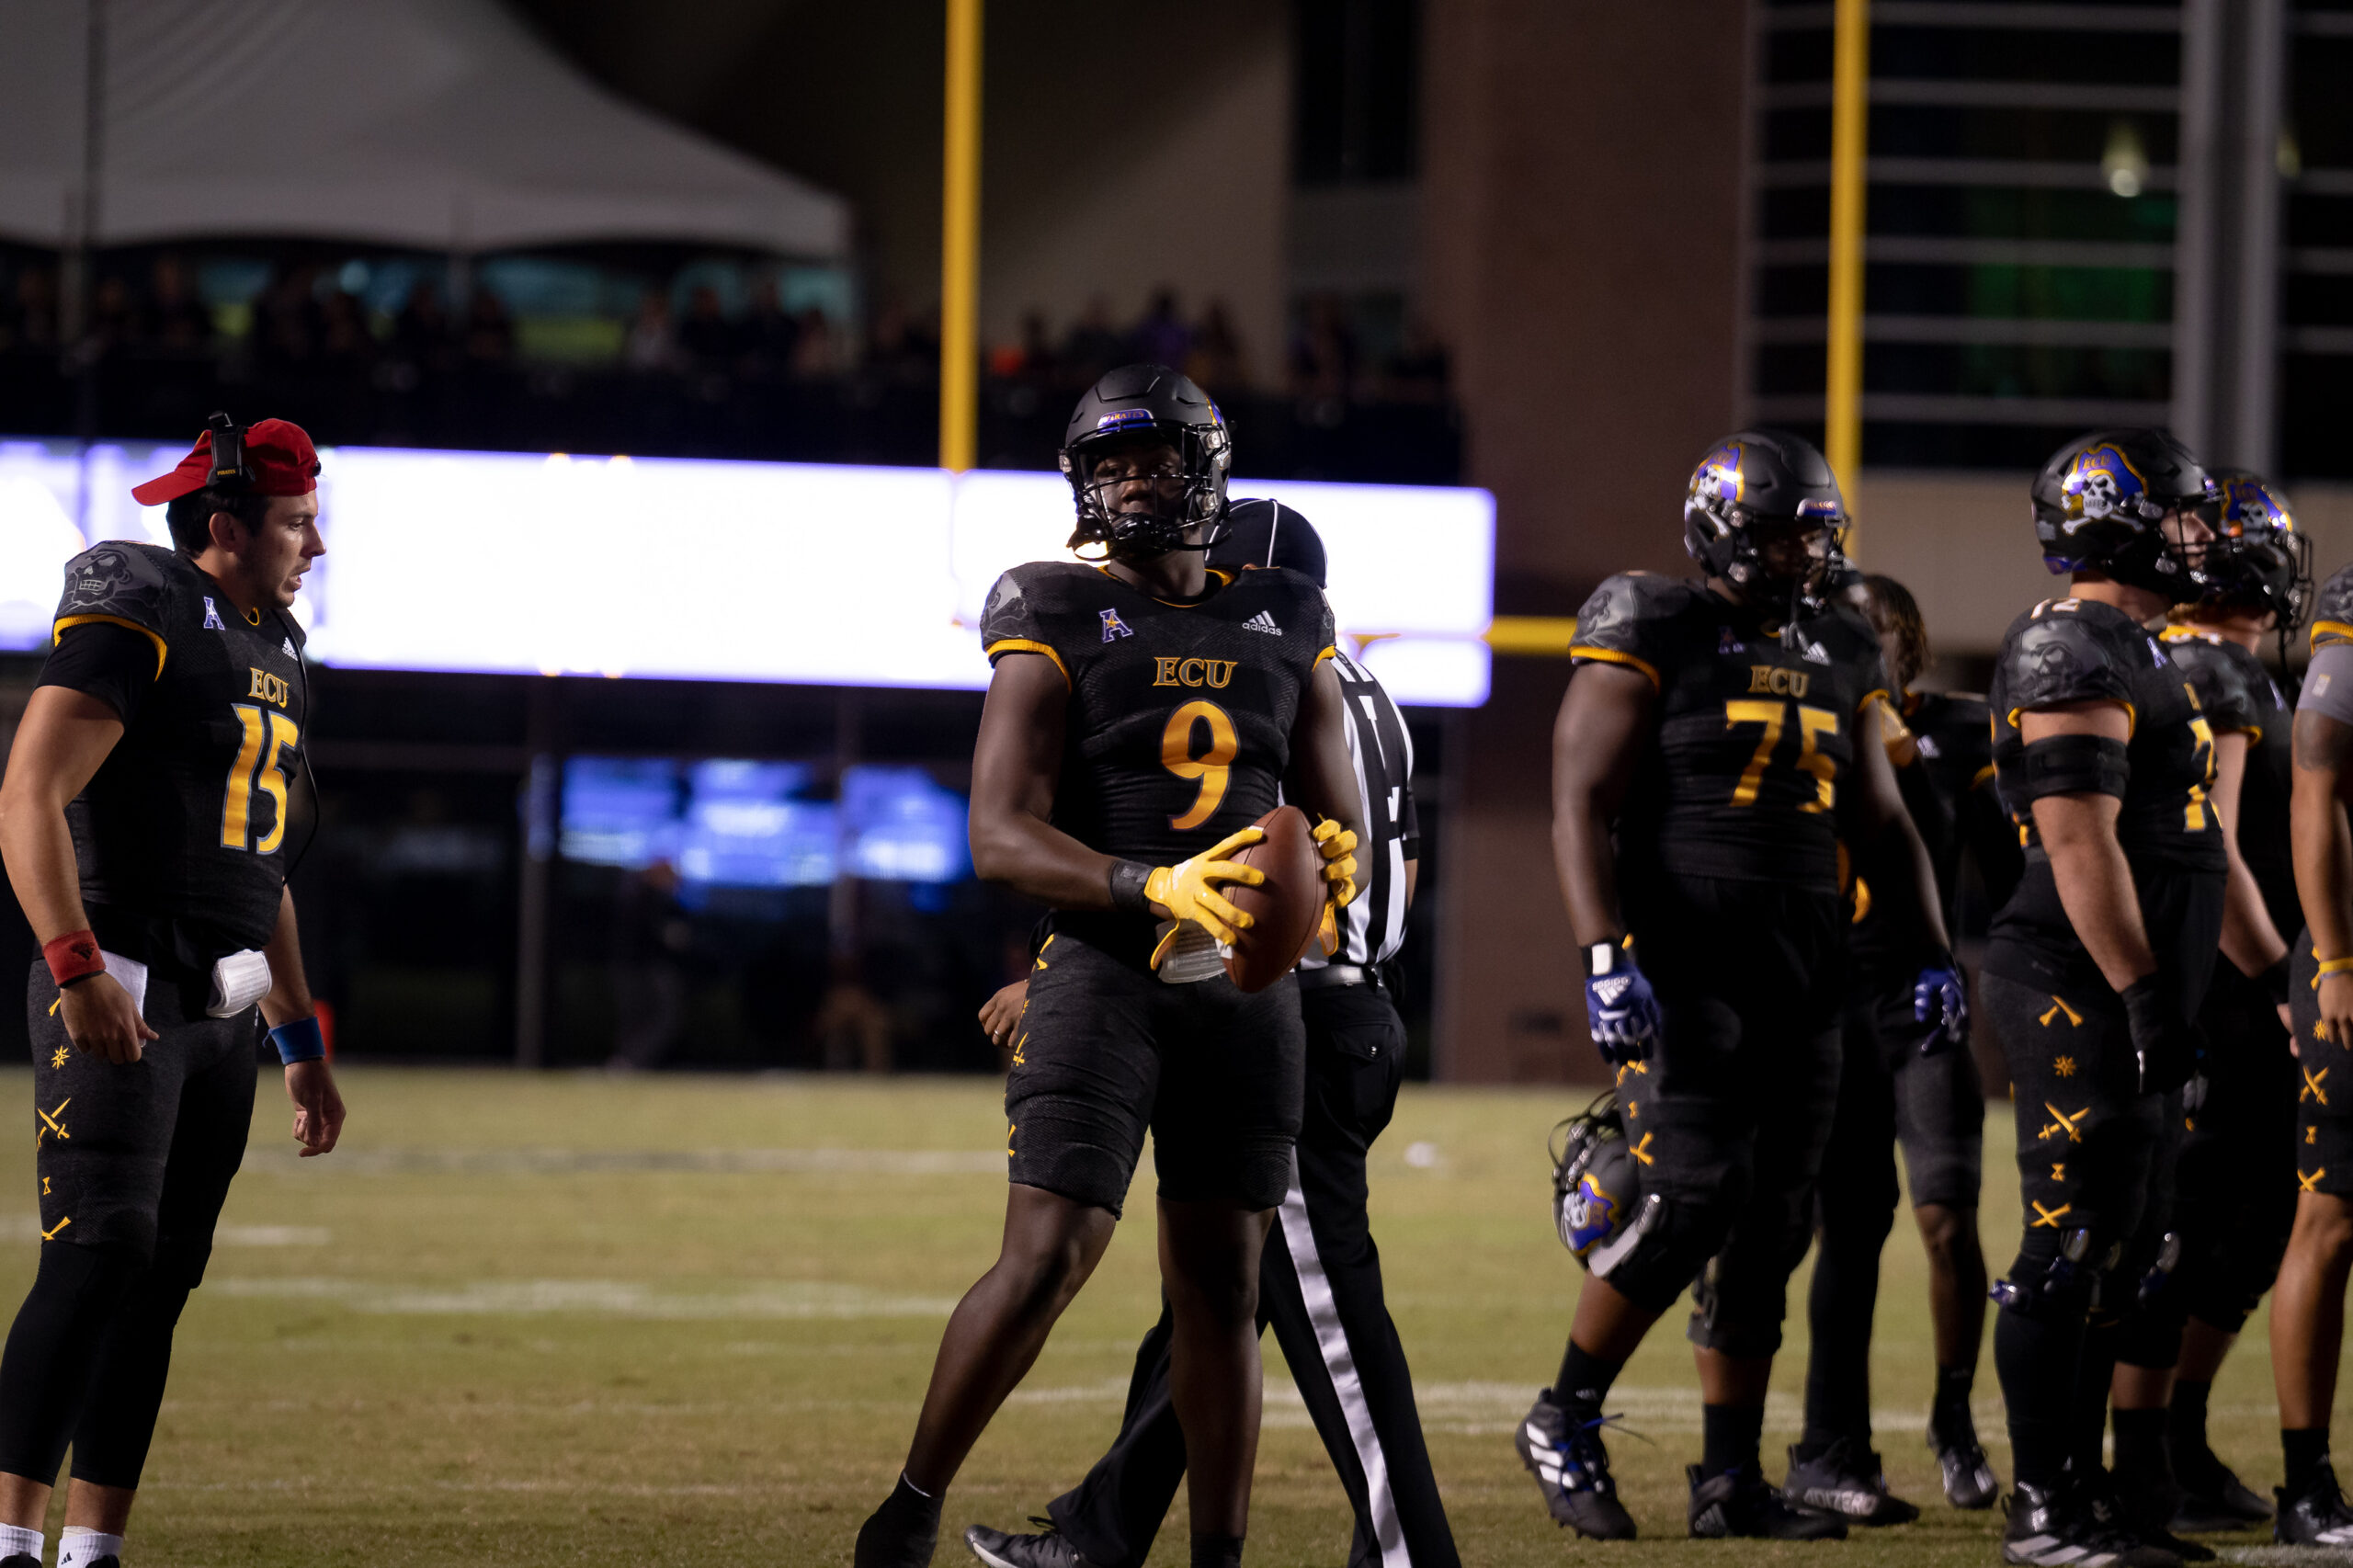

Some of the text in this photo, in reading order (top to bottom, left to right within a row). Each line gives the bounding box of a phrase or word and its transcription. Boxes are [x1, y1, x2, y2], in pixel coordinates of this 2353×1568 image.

[1099, 608, 1134, 643] A
[1242, 621, 1282, 636] adidas
[247, 666, 290, 709] ECU
[1153, 656, 1239, 688] ECU
[1747, 664, 1810, 699] ECU
[1158, 696, 1241, 832] 9
[1724, 698, 1839, 814] 75
[221, 703, 300, 856] 15
